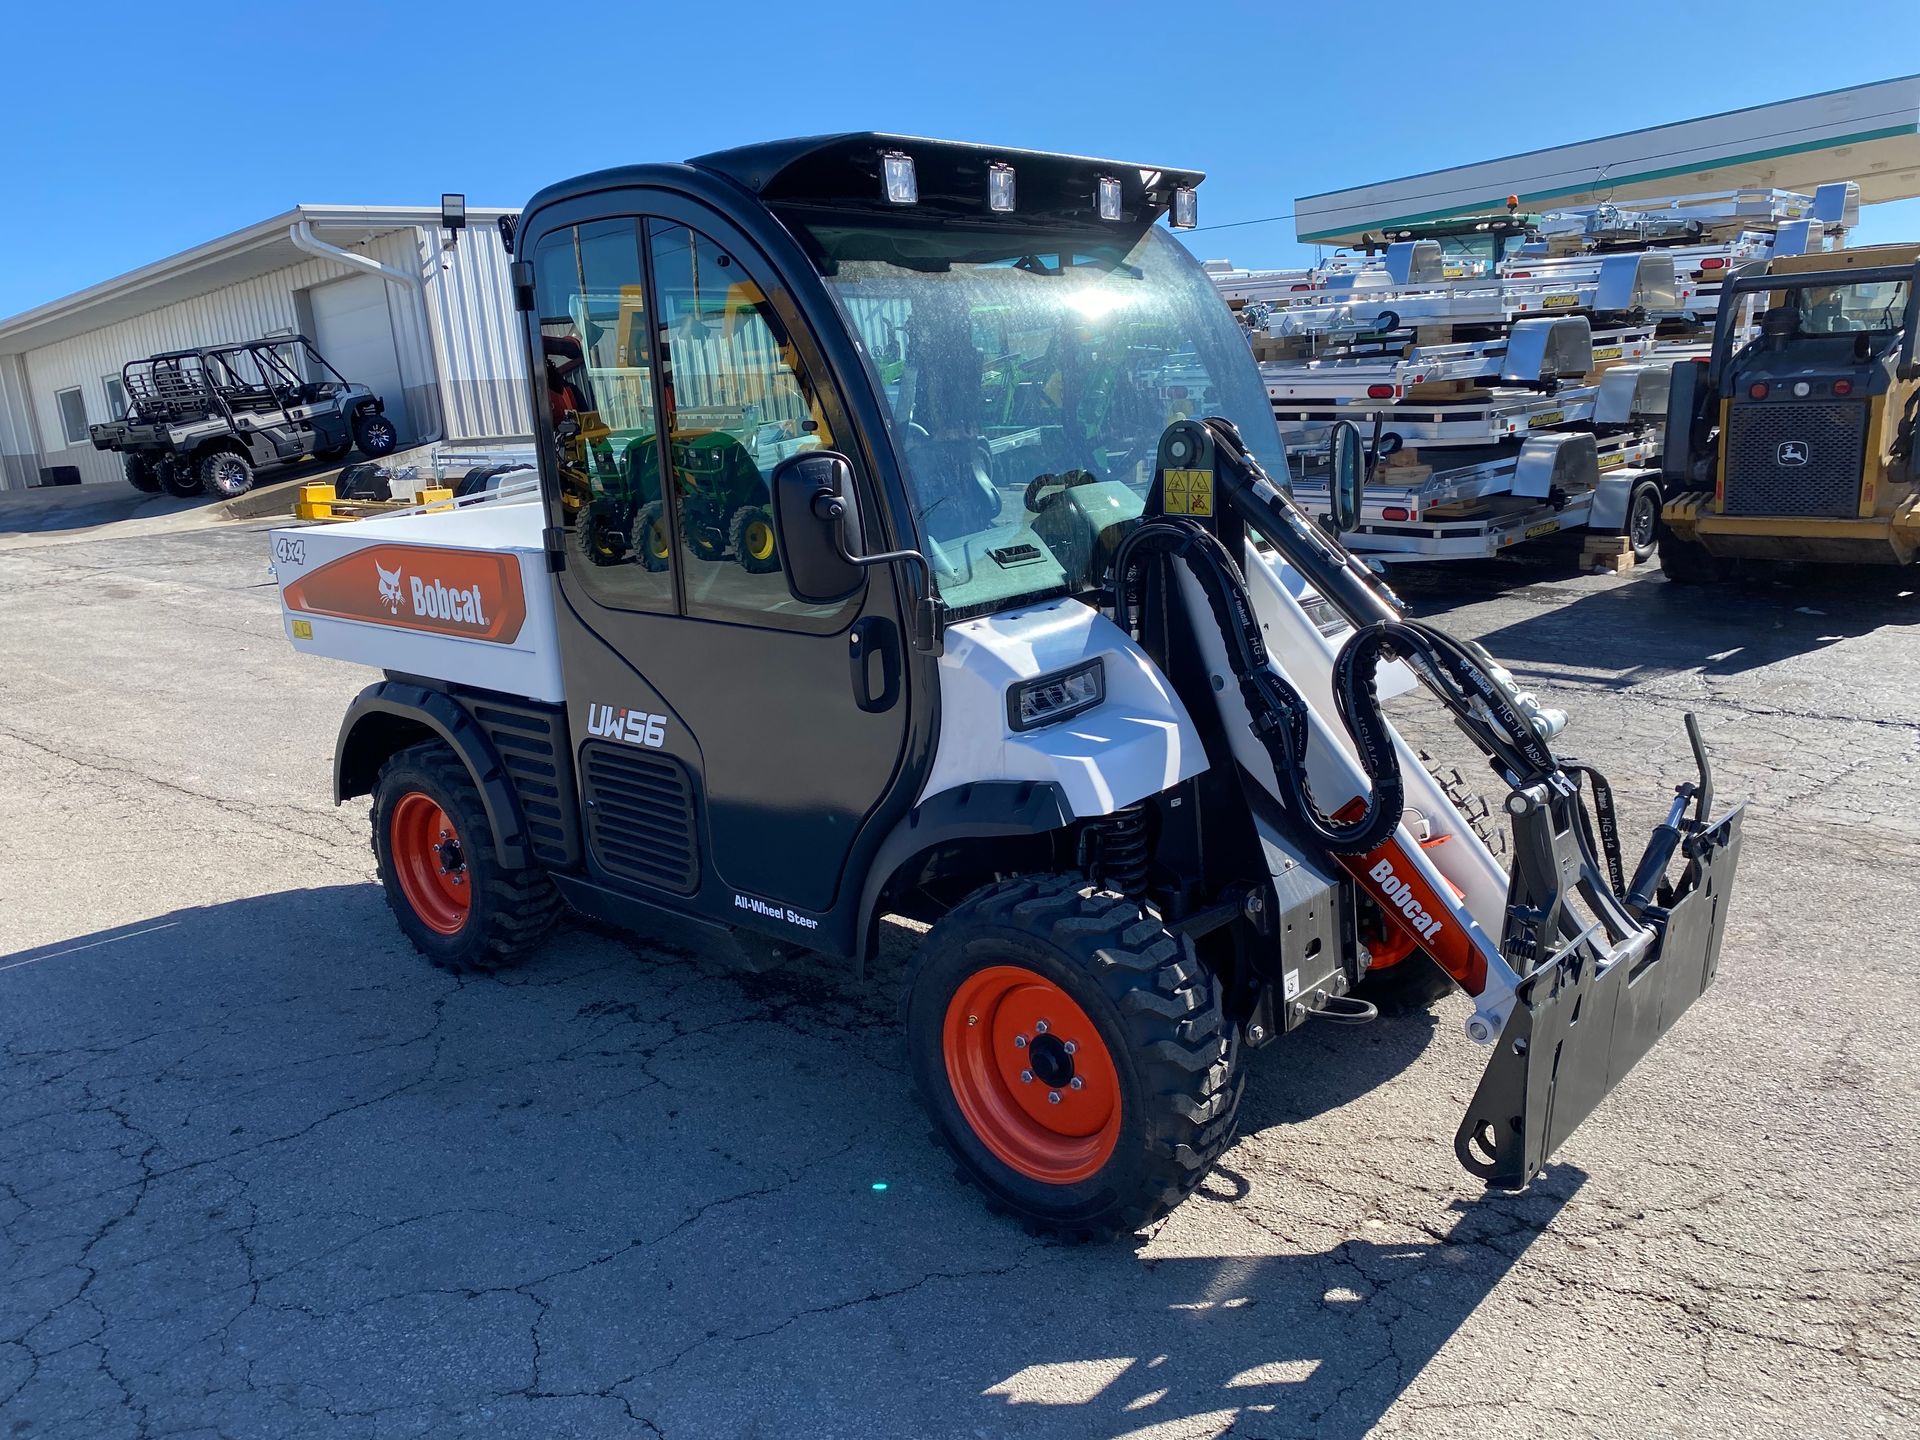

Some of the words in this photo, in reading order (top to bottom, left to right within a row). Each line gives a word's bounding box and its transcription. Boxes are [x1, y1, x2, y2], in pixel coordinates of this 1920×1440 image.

[276, 538, 305, 565] 4x4
[409, 575, 486, 626] Bobcat
[1248, 635, 1265, 666] HG-1
[1468, 667, 1495, 697] Bobcat
[1497, 702, 1527, 738] HG-14
[587, 703, 668, 748] UW56
[1600, 816, 1616, 849] HG-14
[734, 894, 784, 920] All-Wheel
[786, 909, 819, 930] Steer
[1368, 858, 1444, 942] Bobcat
